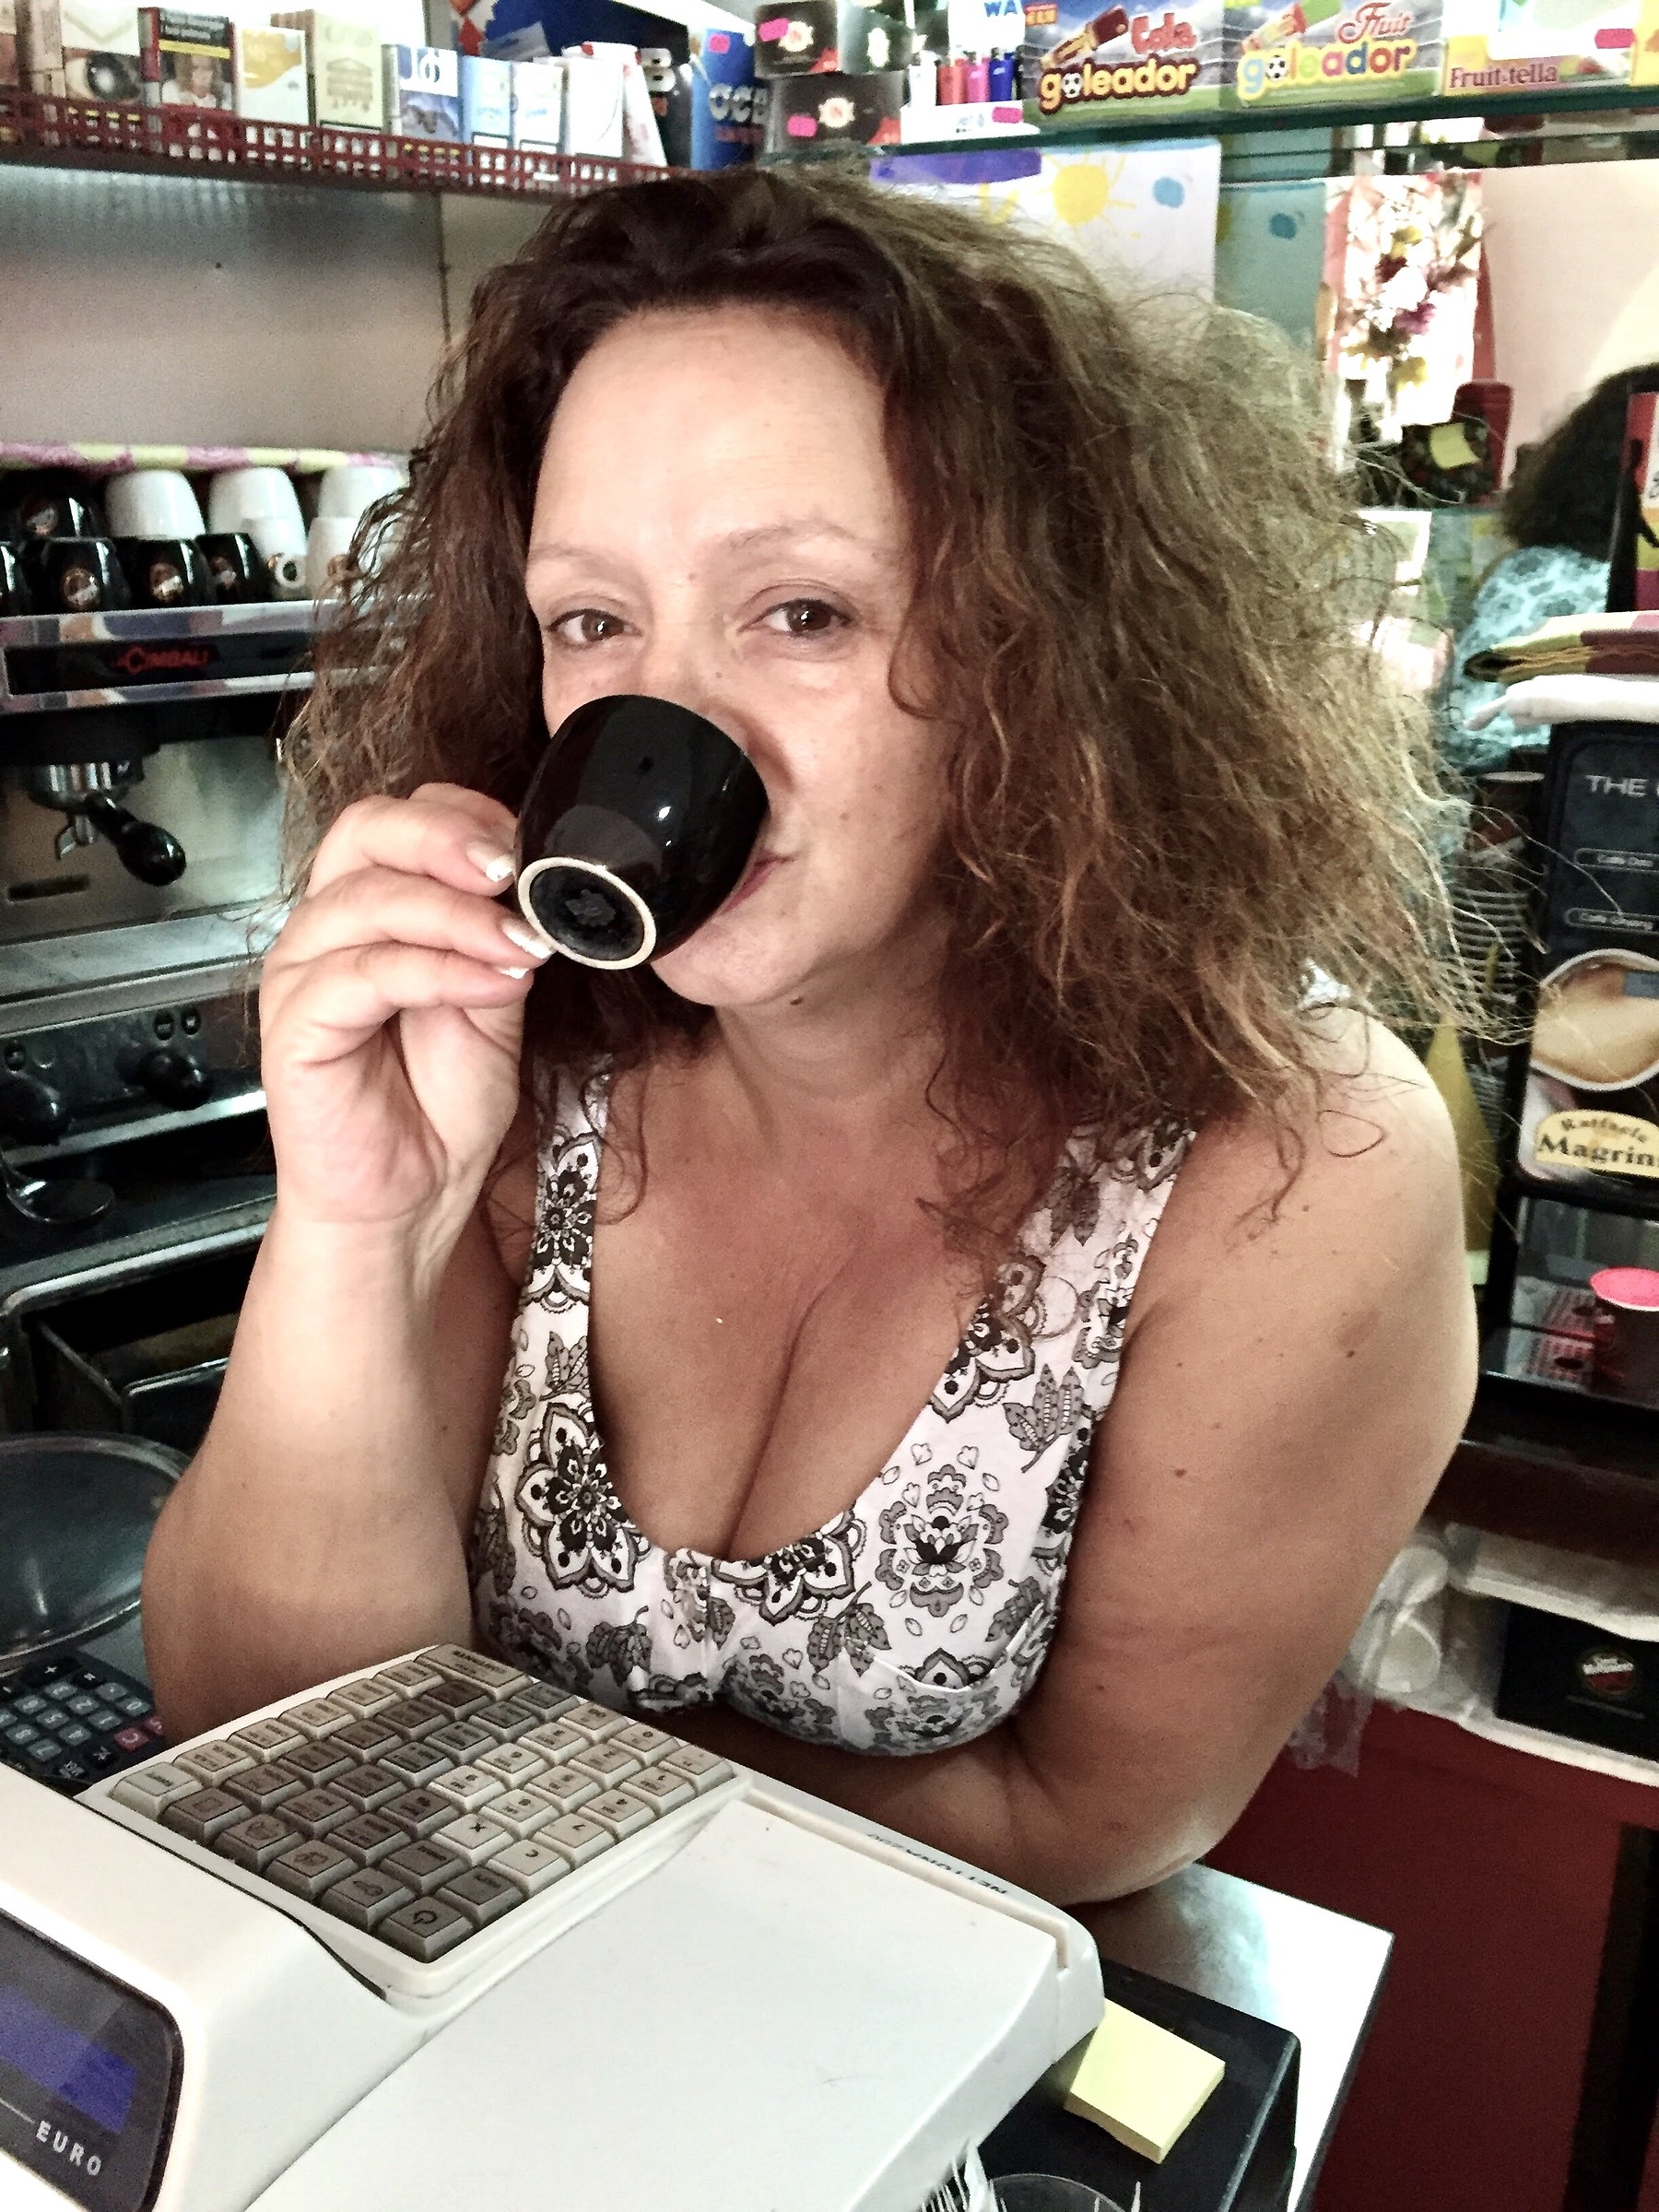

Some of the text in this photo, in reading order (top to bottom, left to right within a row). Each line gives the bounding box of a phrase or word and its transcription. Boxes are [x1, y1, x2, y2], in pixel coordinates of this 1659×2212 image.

[1131, 13, 1198, 54] Cola
[1336, 2, 1412, 43] Fruit
[1040, 57, 1198, 109] goleador
[1242, 42, 1411, 93] goleador
[1584, 774, 1648, 797] THE
[1536, 1134, 1659, 1167] Magrin
[36, 2120, 101, 2176] EURO
